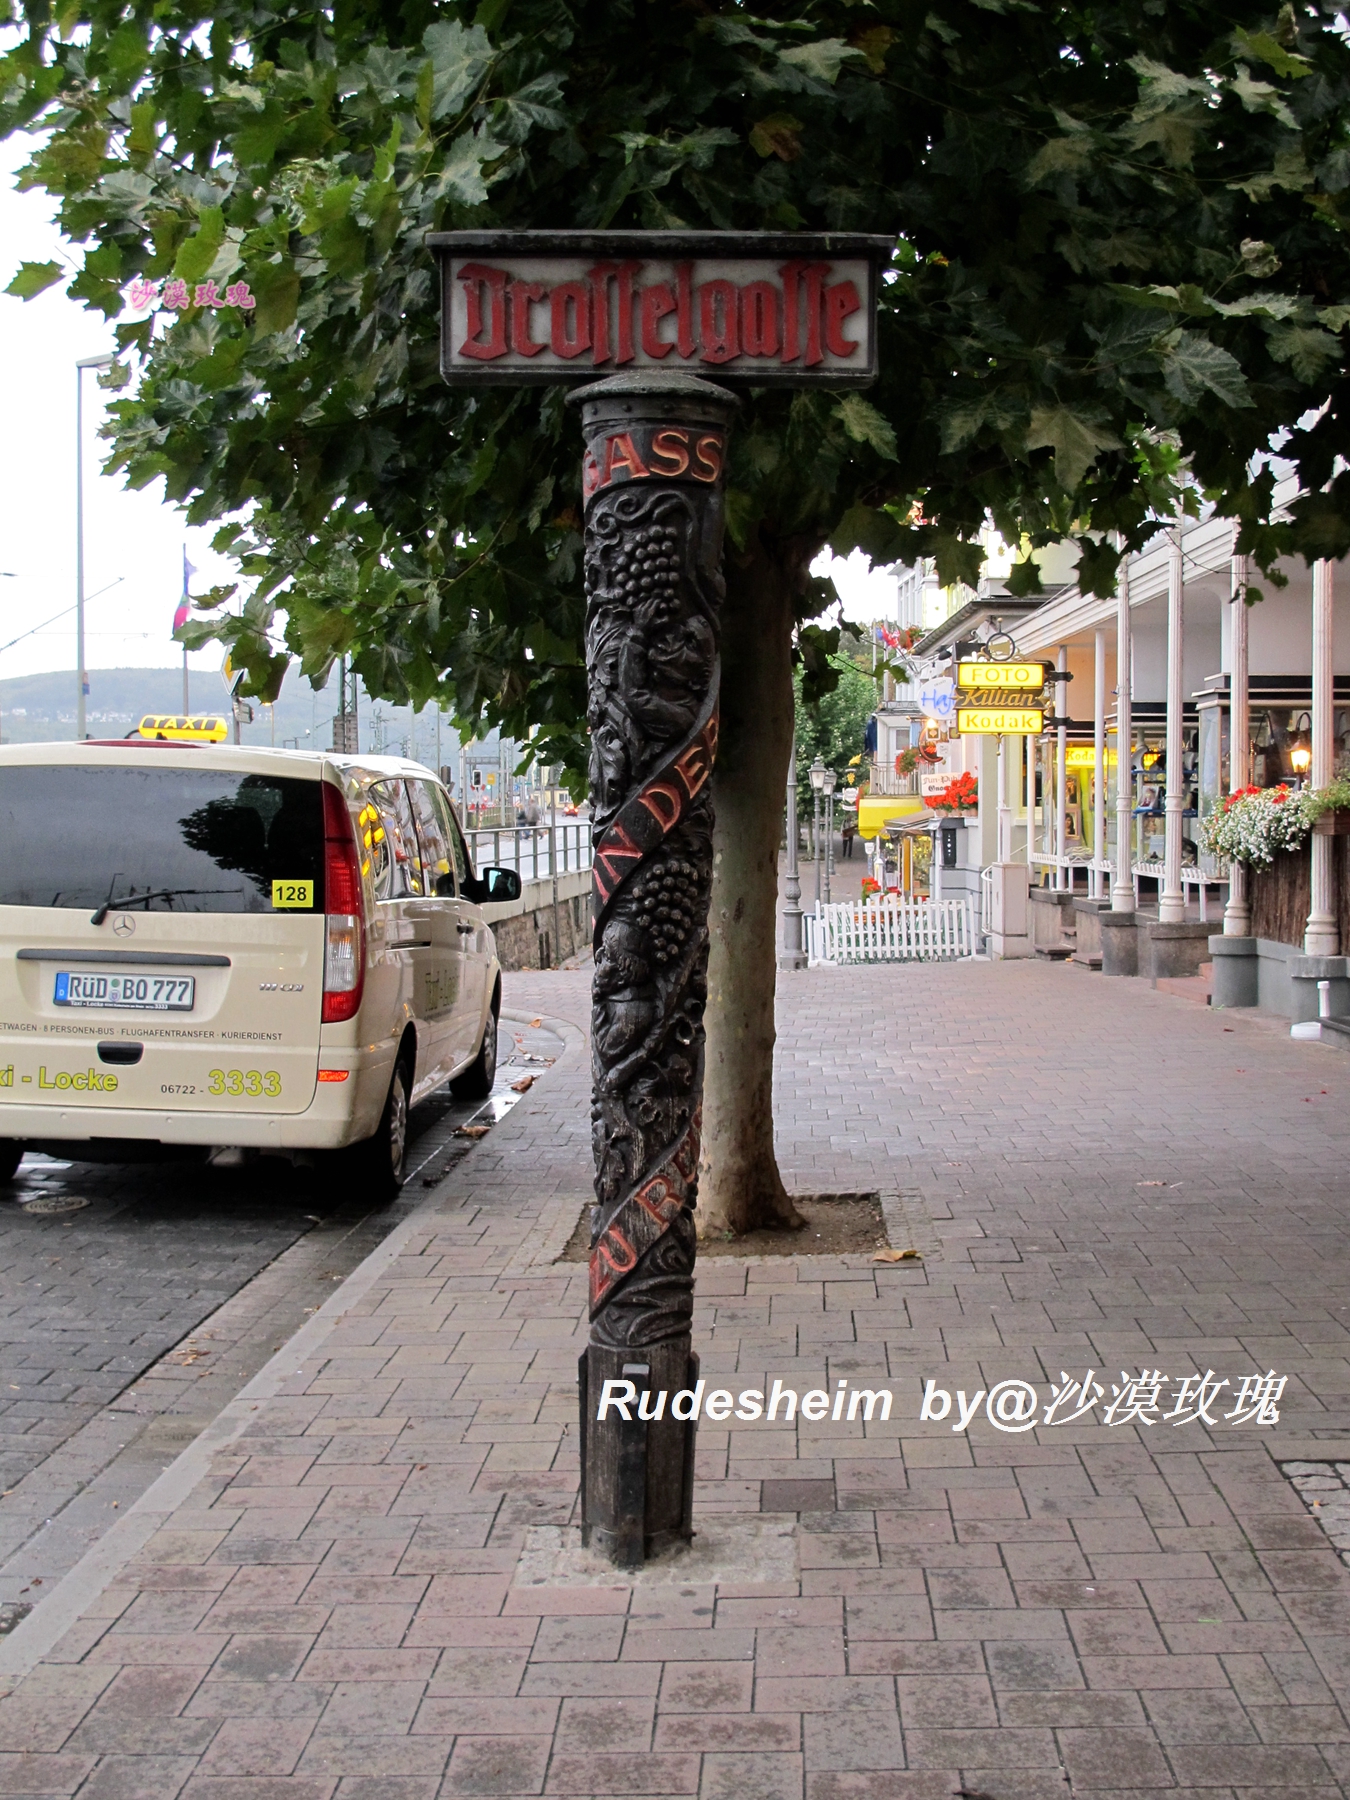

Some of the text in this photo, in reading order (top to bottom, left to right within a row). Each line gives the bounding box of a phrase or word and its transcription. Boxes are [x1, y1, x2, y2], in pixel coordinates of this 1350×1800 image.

[972, 668, 1029, 682] FOTO
[961, 688, 1037, 707] Killian
[153, 717, 210, 731] TAXI
[966, 714, 1034, 728] Kodak
[1065, 750, 1095, 761] Koda
[276, 886, 307, 901] 128
[153, 979, 190, 1002] 777
[43, 1025, 48, 1033] 8
[50, 1025, 115, 1036] PERSONEN-BUS
[121, 1028, 215, 1039] FLUGHAFENTRANSFER
[221, 1031, 283, 1040] KURIERDIENST
[39, 1065, 118, 1091] Locke
[160, 1084, 196, 1094] 06722
[208, 1068, 282, 1097] 3333
